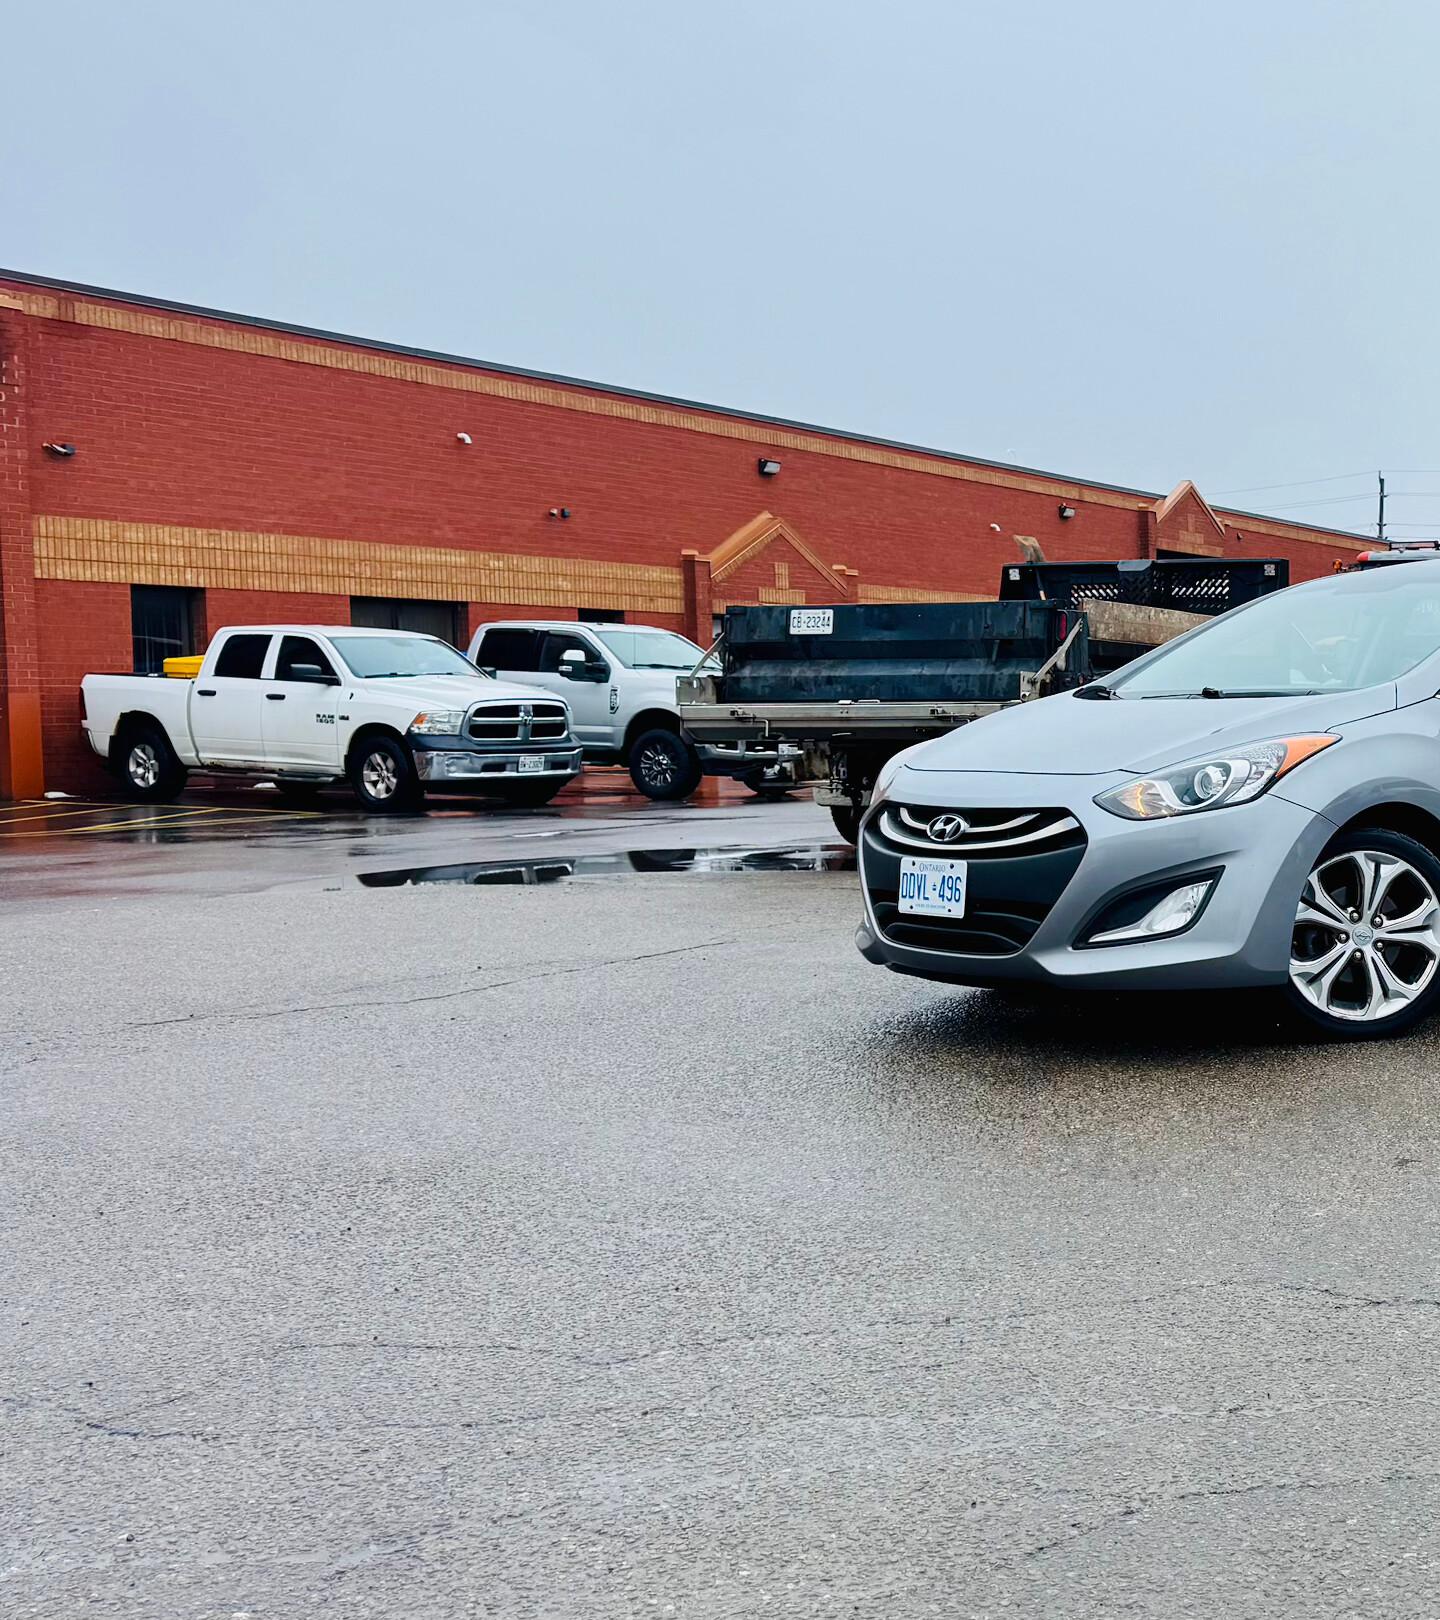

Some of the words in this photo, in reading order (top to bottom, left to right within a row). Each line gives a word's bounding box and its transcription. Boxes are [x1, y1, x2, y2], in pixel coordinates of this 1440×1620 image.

[806, 616, 831, 628] 23244
[901, 872, 930, 901] DDVL
[938, 874, 962, 903] 496
